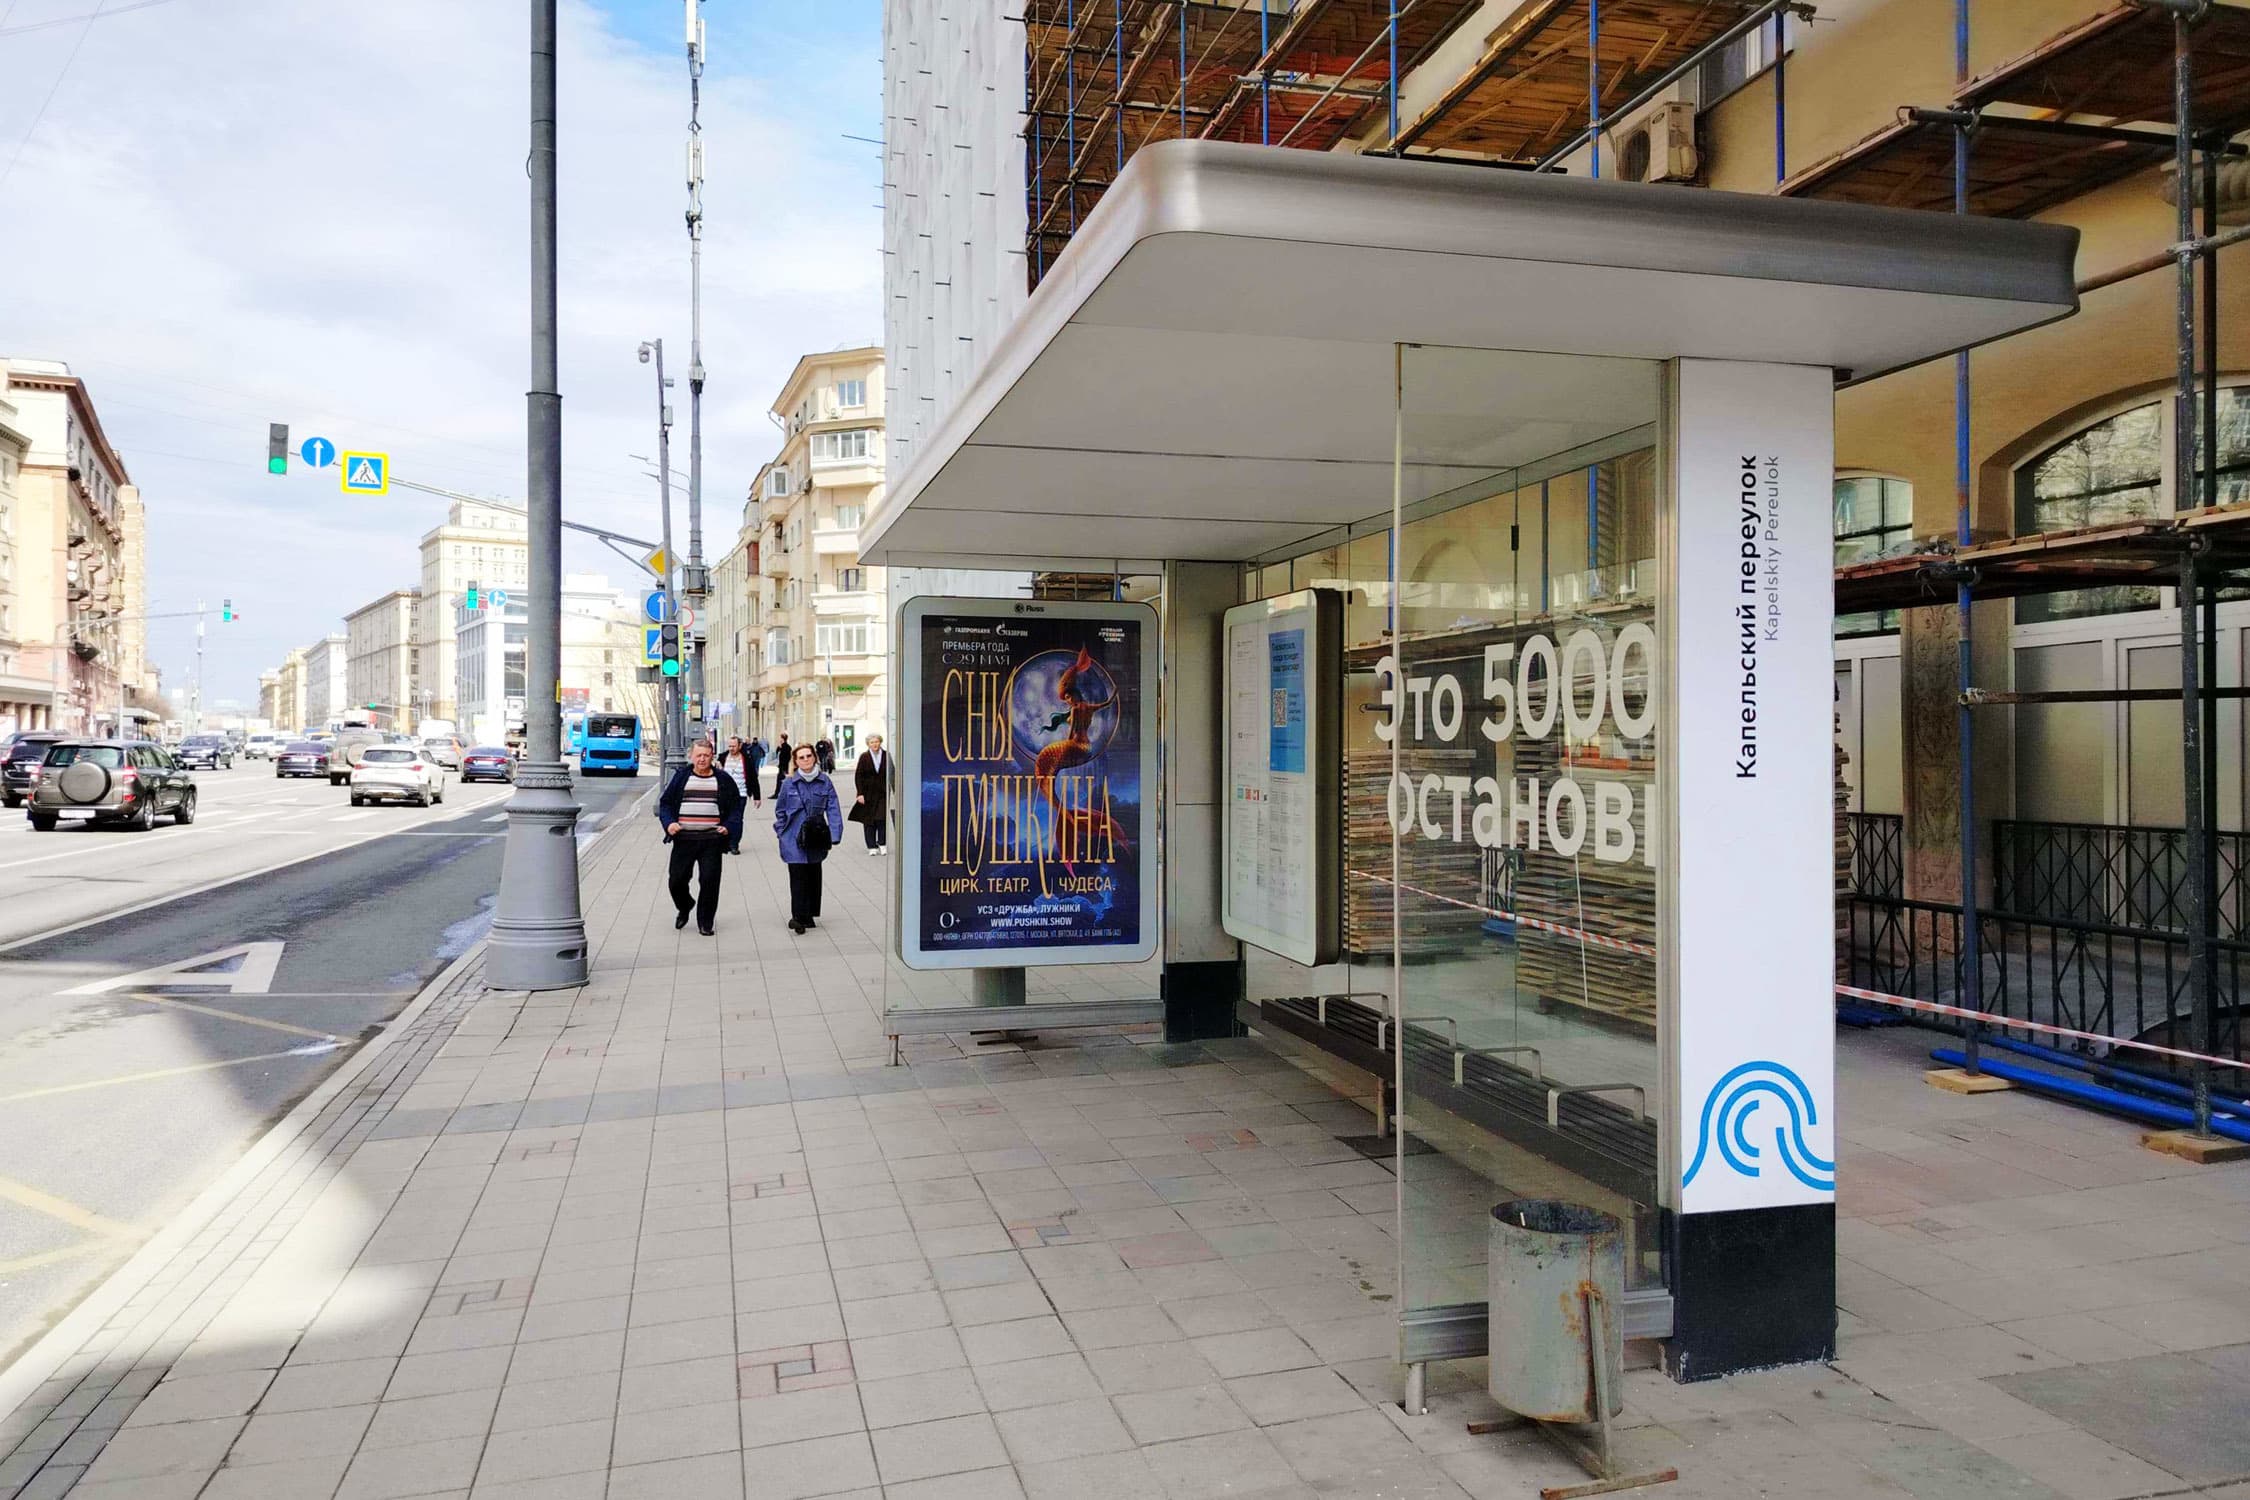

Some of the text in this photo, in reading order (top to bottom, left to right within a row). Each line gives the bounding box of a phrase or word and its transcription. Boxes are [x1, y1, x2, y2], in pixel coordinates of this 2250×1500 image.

[1764, 456, 1782, 641] Kapelskiy Pereulok
[1736, 456, 1761, 778] Капельский переулок
[942, 641, 1010, 652] ПРЕМЬЕРА ГОДА
[942, 653, 1010, 665] С 29 МАЯ
[1374, 622, 1656, 742] Это 5000
[942, 667, 1016, 763] СНЫ
[940, 773, 1116, 899] ПУШКИНА
[940, 876, 1116, 896] ЦИРК. ТЕАТР. ЧУДЕСА.
[1040, 904, 1081, 914] ЛУЖНИКИ
[990, 917, 1073, 927] WWW.PUSHKIN.SHOW
